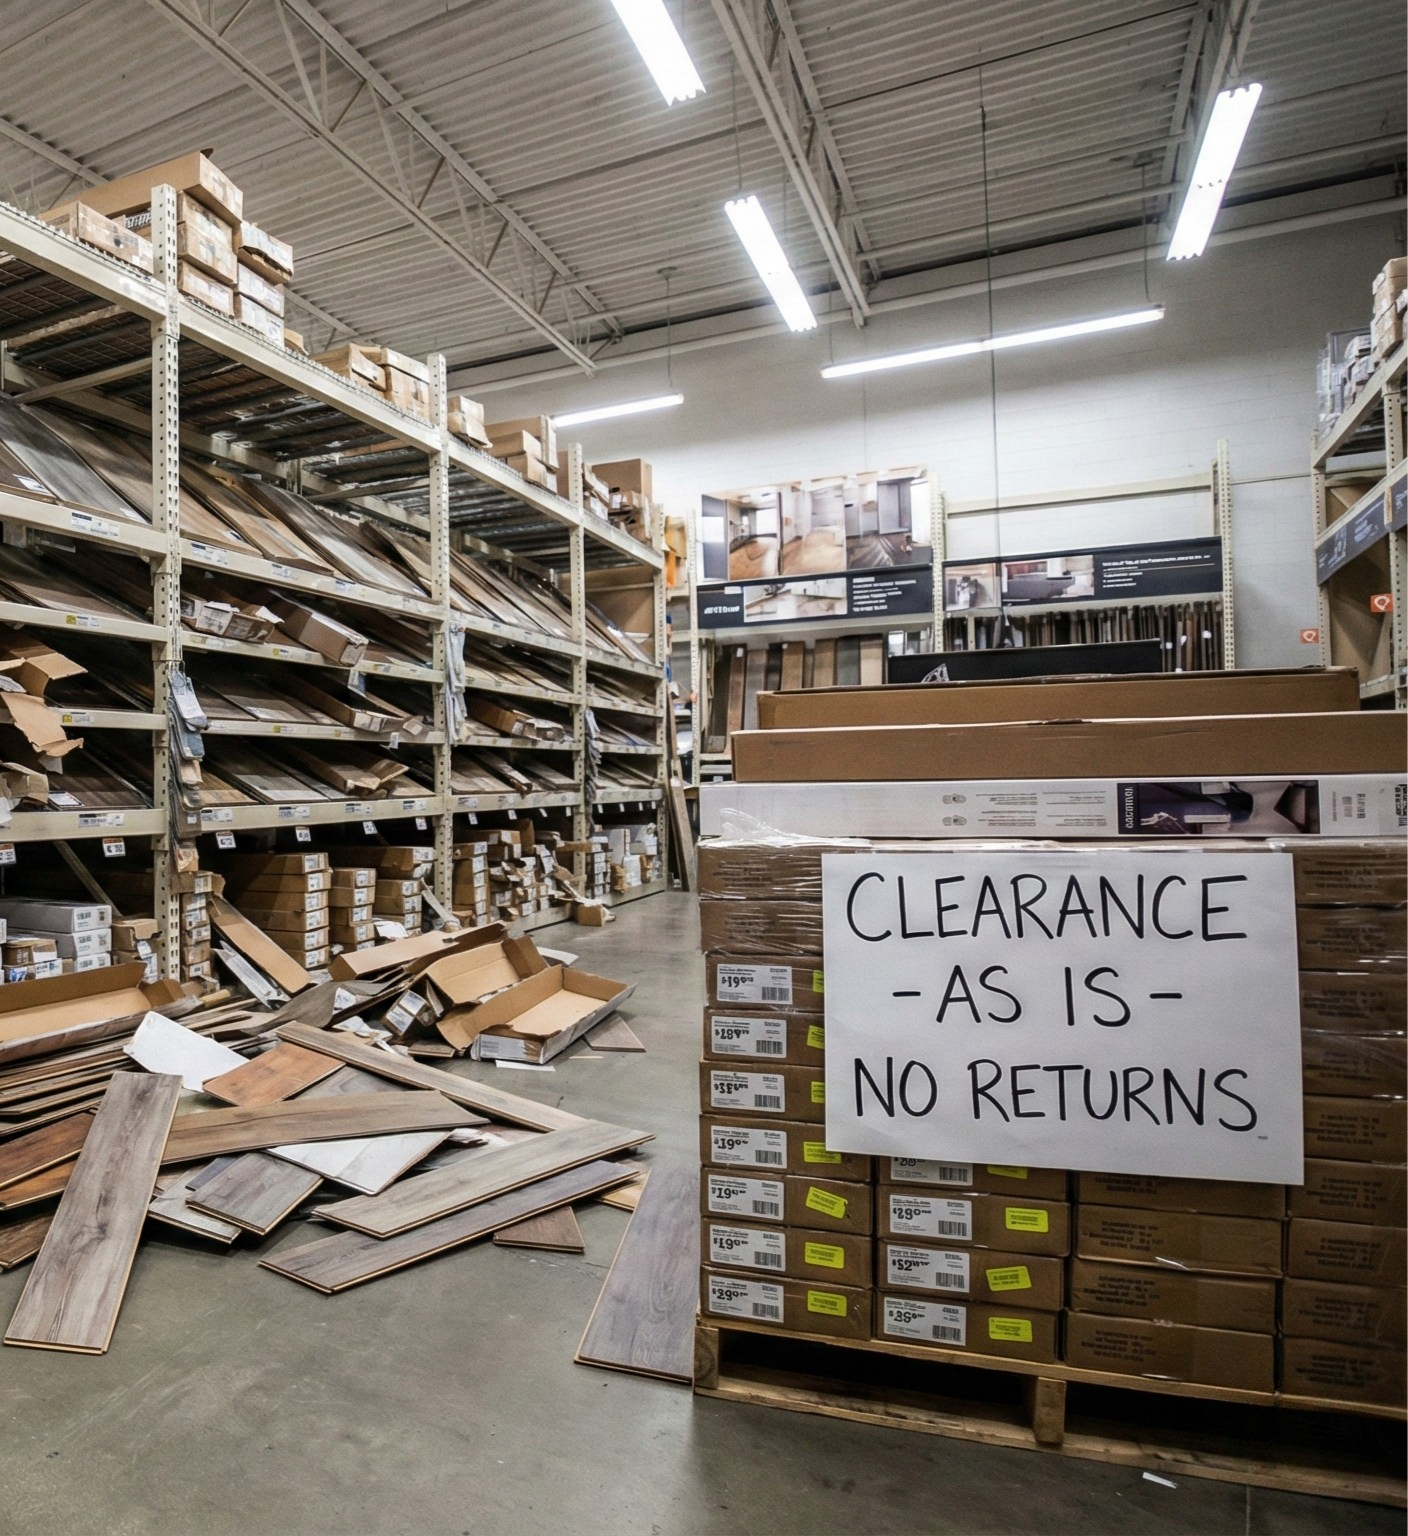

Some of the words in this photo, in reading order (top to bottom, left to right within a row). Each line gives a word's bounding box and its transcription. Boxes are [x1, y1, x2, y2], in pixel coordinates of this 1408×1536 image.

[846, 872, 1248, 942] CLEARANCE
[854, 1056, 938, 1118] NO
[967, 1058, 1259, 1132] RETURNS
